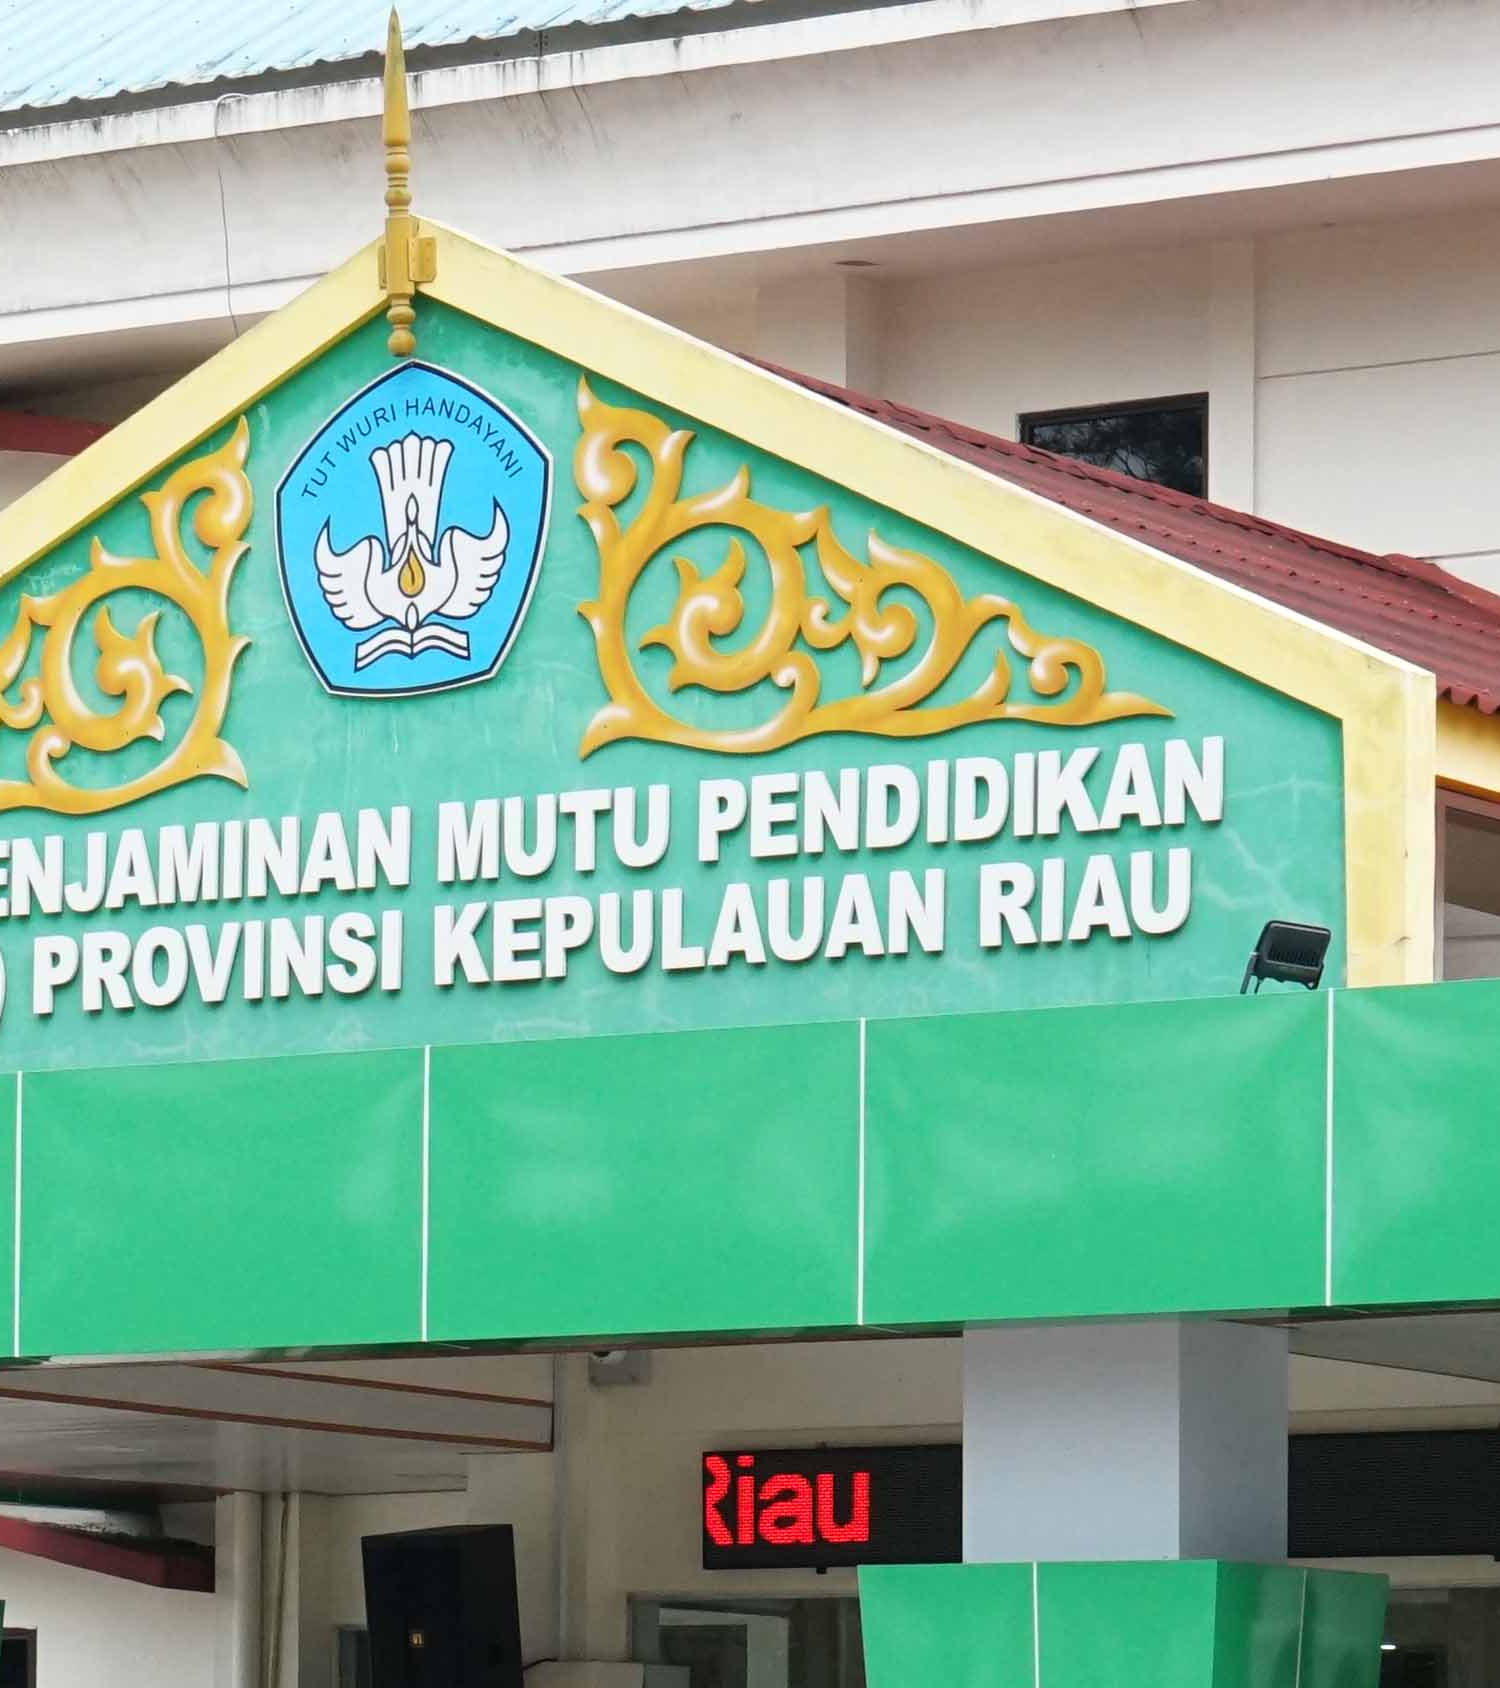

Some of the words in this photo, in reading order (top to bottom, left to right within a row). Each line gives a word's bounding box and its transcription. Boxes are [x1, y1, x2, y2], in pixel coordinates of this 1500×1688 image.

[302, 452, 340, 498] TUT
[337, 403, 398, 453] WURI
[406, 397, 524, 478] HANDAYANI
[437, 783, 671, 883] MUTU
[698, 735, 1225, 863] PENDIDIKAN
[32, 909, 401, 1015] PROVINSI
[433, 868, 944, 985] KEPULAUAN
[979, 847, 1192, 947] RIAU
